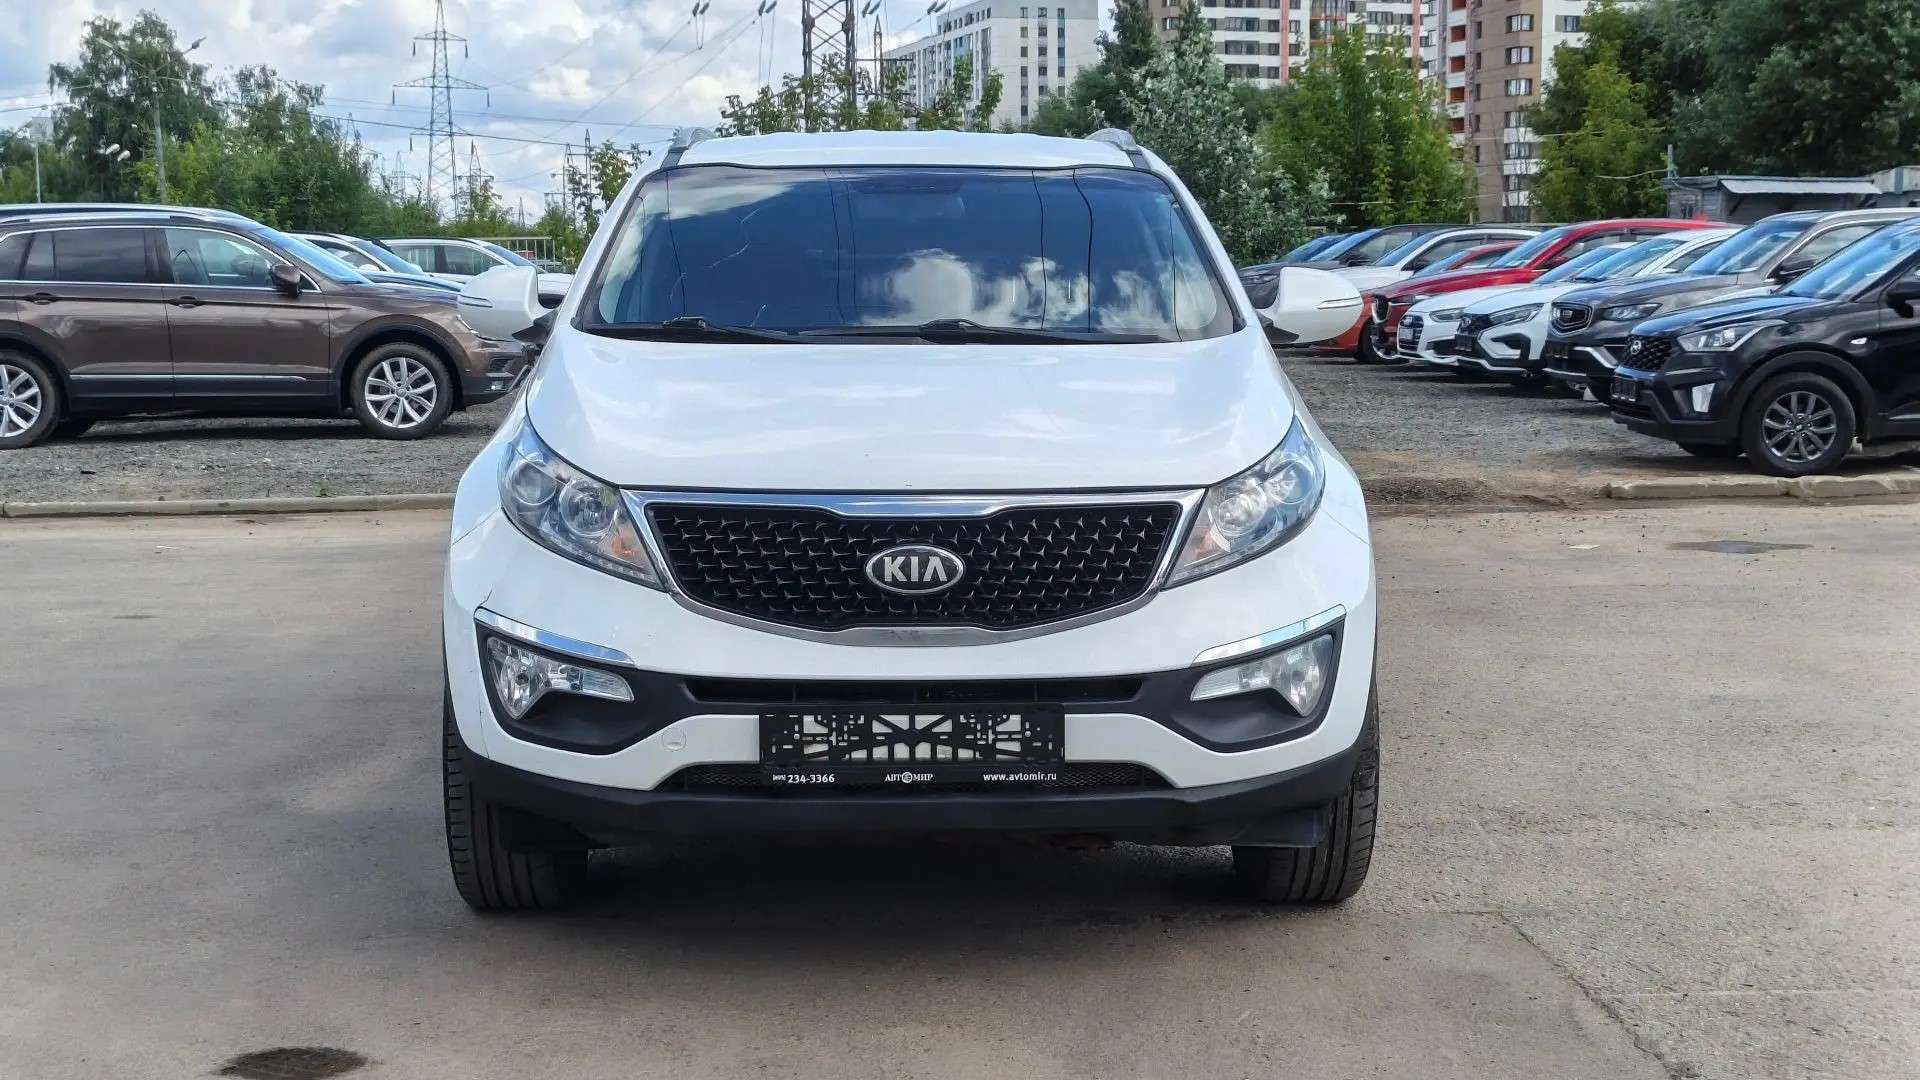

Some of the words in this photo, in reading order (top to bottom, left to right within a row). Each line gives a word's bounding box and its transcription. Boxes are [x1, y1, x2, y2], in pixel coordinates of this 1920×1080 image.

[883, 556, 948, 582] KIA
[787, 774, 835, 783] 234-3366
[983, 771, 1057, 781] www.avtomir.ru
